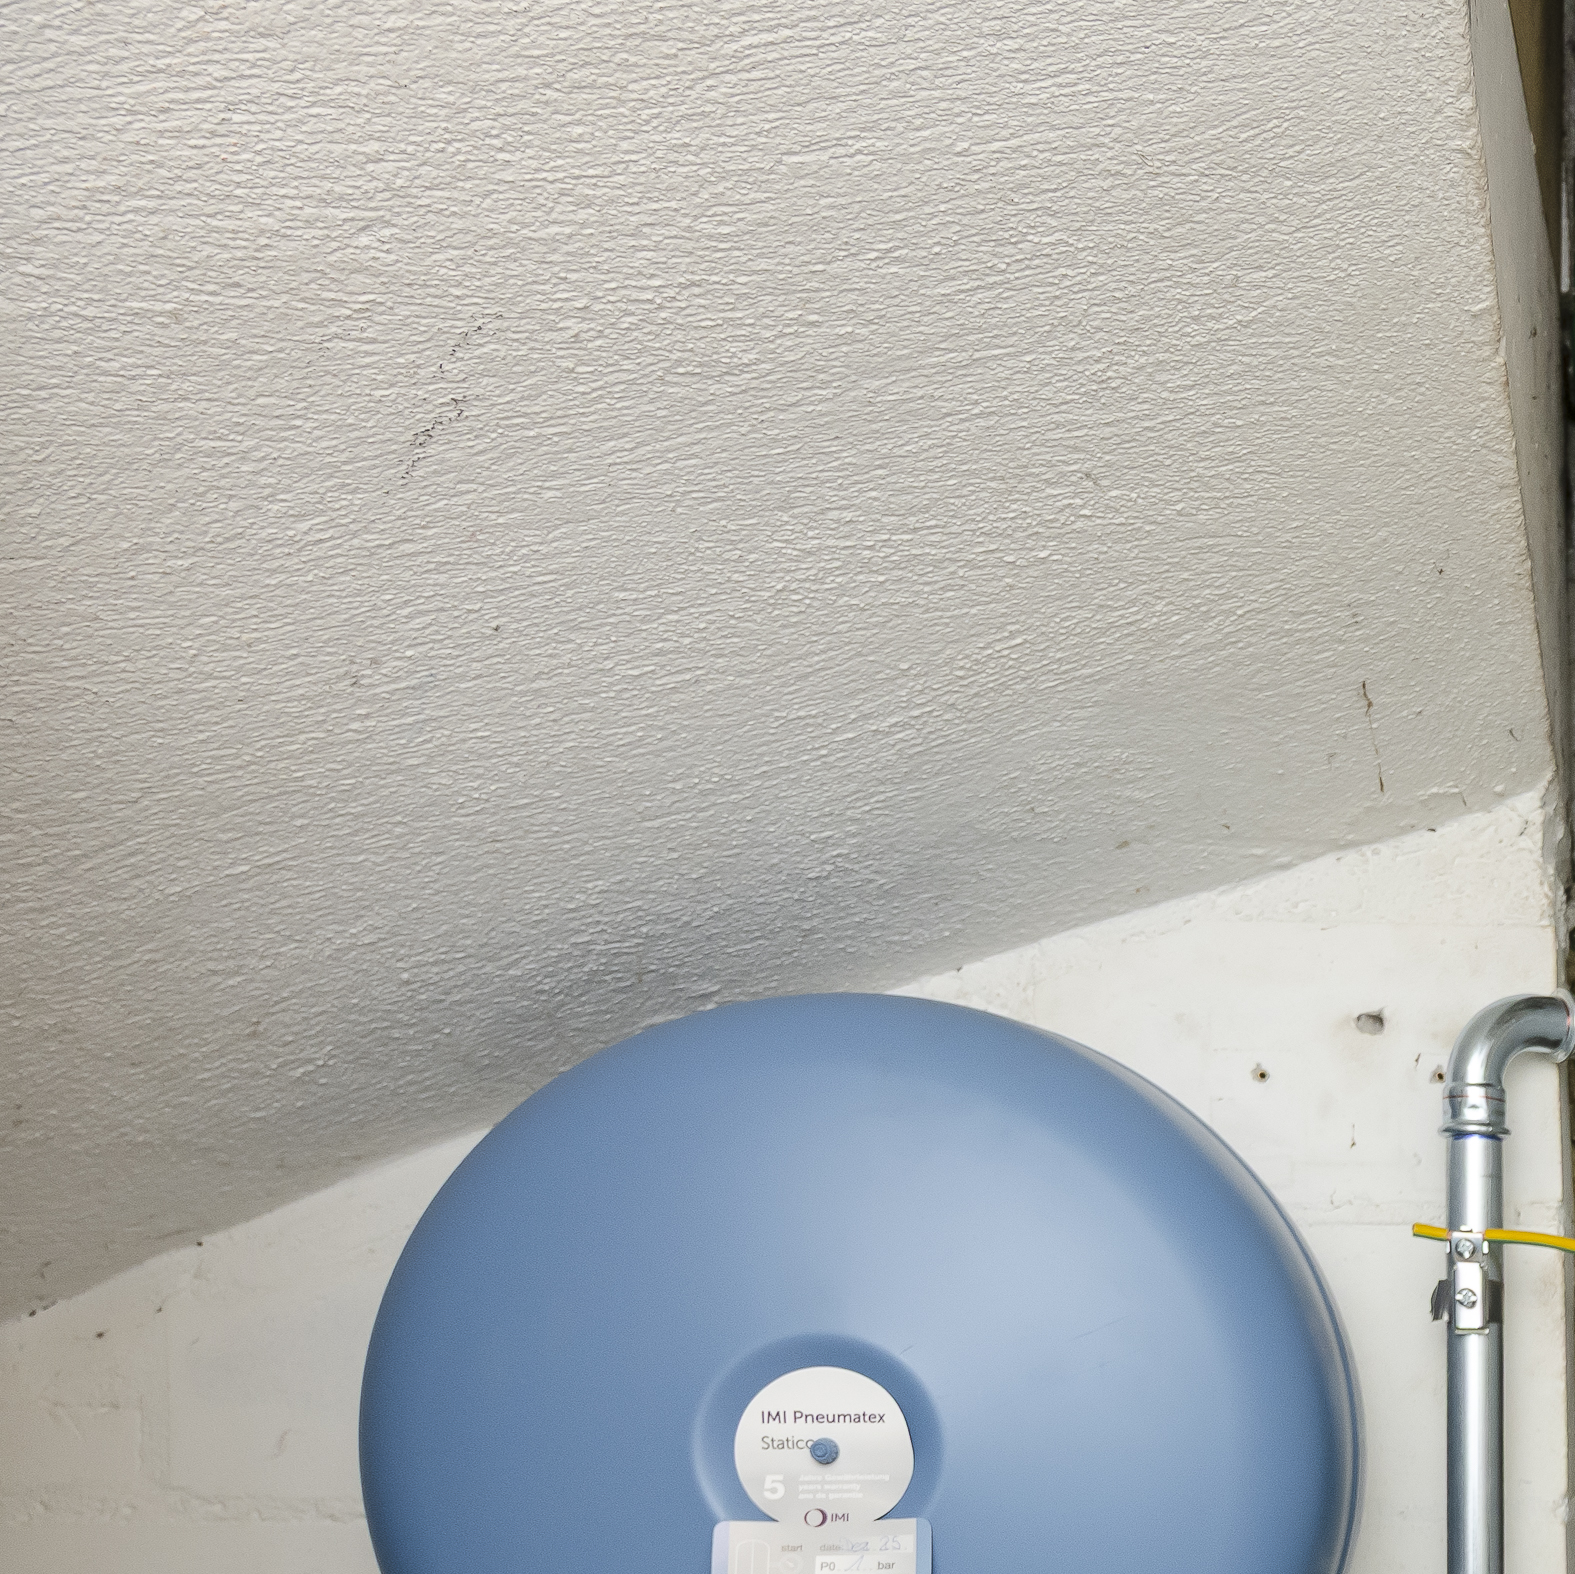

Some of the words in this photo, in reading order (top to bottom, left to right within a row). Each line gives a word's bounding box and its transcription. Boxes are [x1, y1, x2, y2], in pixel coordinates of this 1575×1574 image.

[761, 1410, 786, 1424] IMI
[794, 1410, 886, 1424] Pneumatex
[763, 1474, 786, 1500] 5
[831, 1513, 850, 1522] IMI
[878, 1561, 896, 1570] bar
